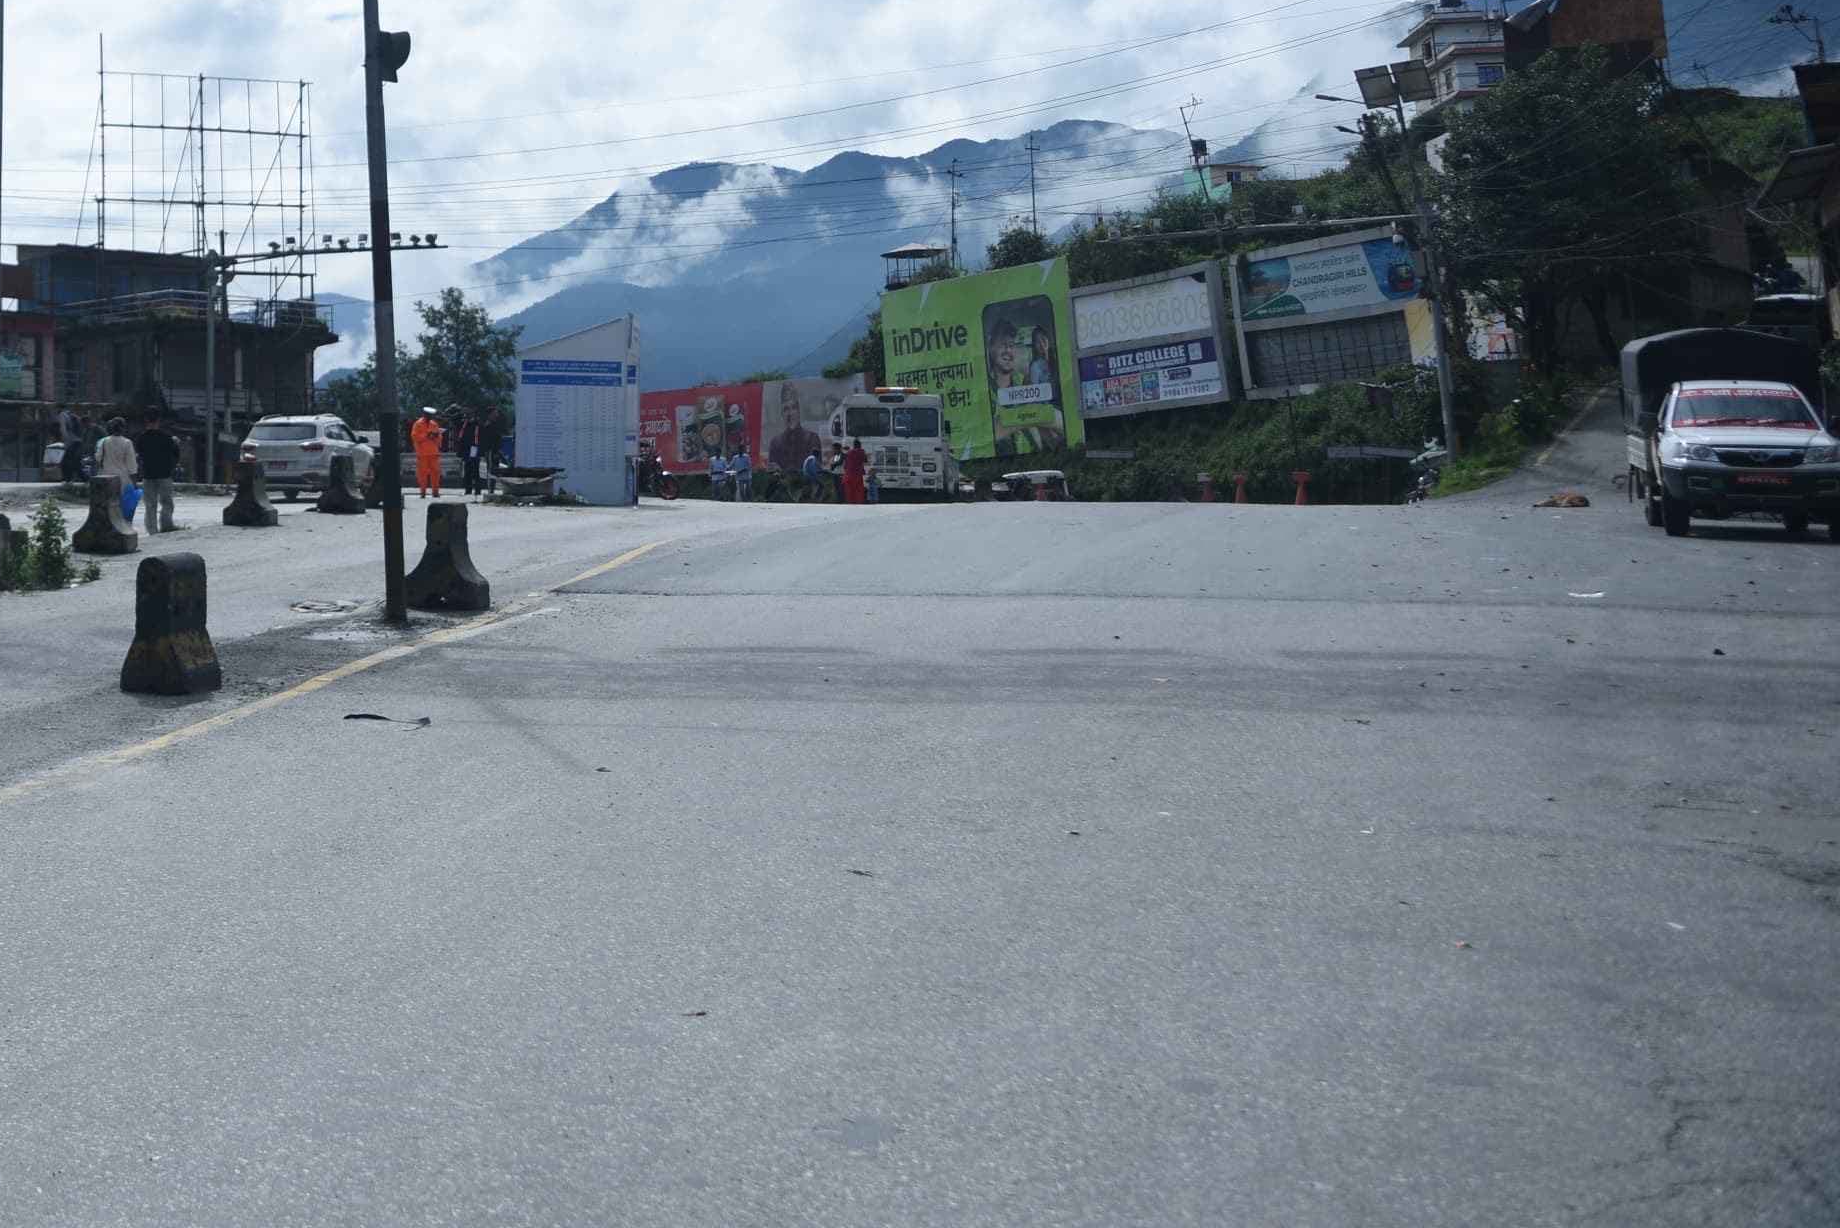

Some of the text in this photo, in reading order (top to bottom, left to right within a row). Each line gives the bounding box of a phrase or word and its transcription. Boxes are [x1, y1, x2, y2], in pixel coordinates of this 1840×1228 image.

[892, 321, 968, 356] inDrive
[1108, 353, 1134, 369] RITZ
[1135, 345, 1185, 364] COLLEGE
